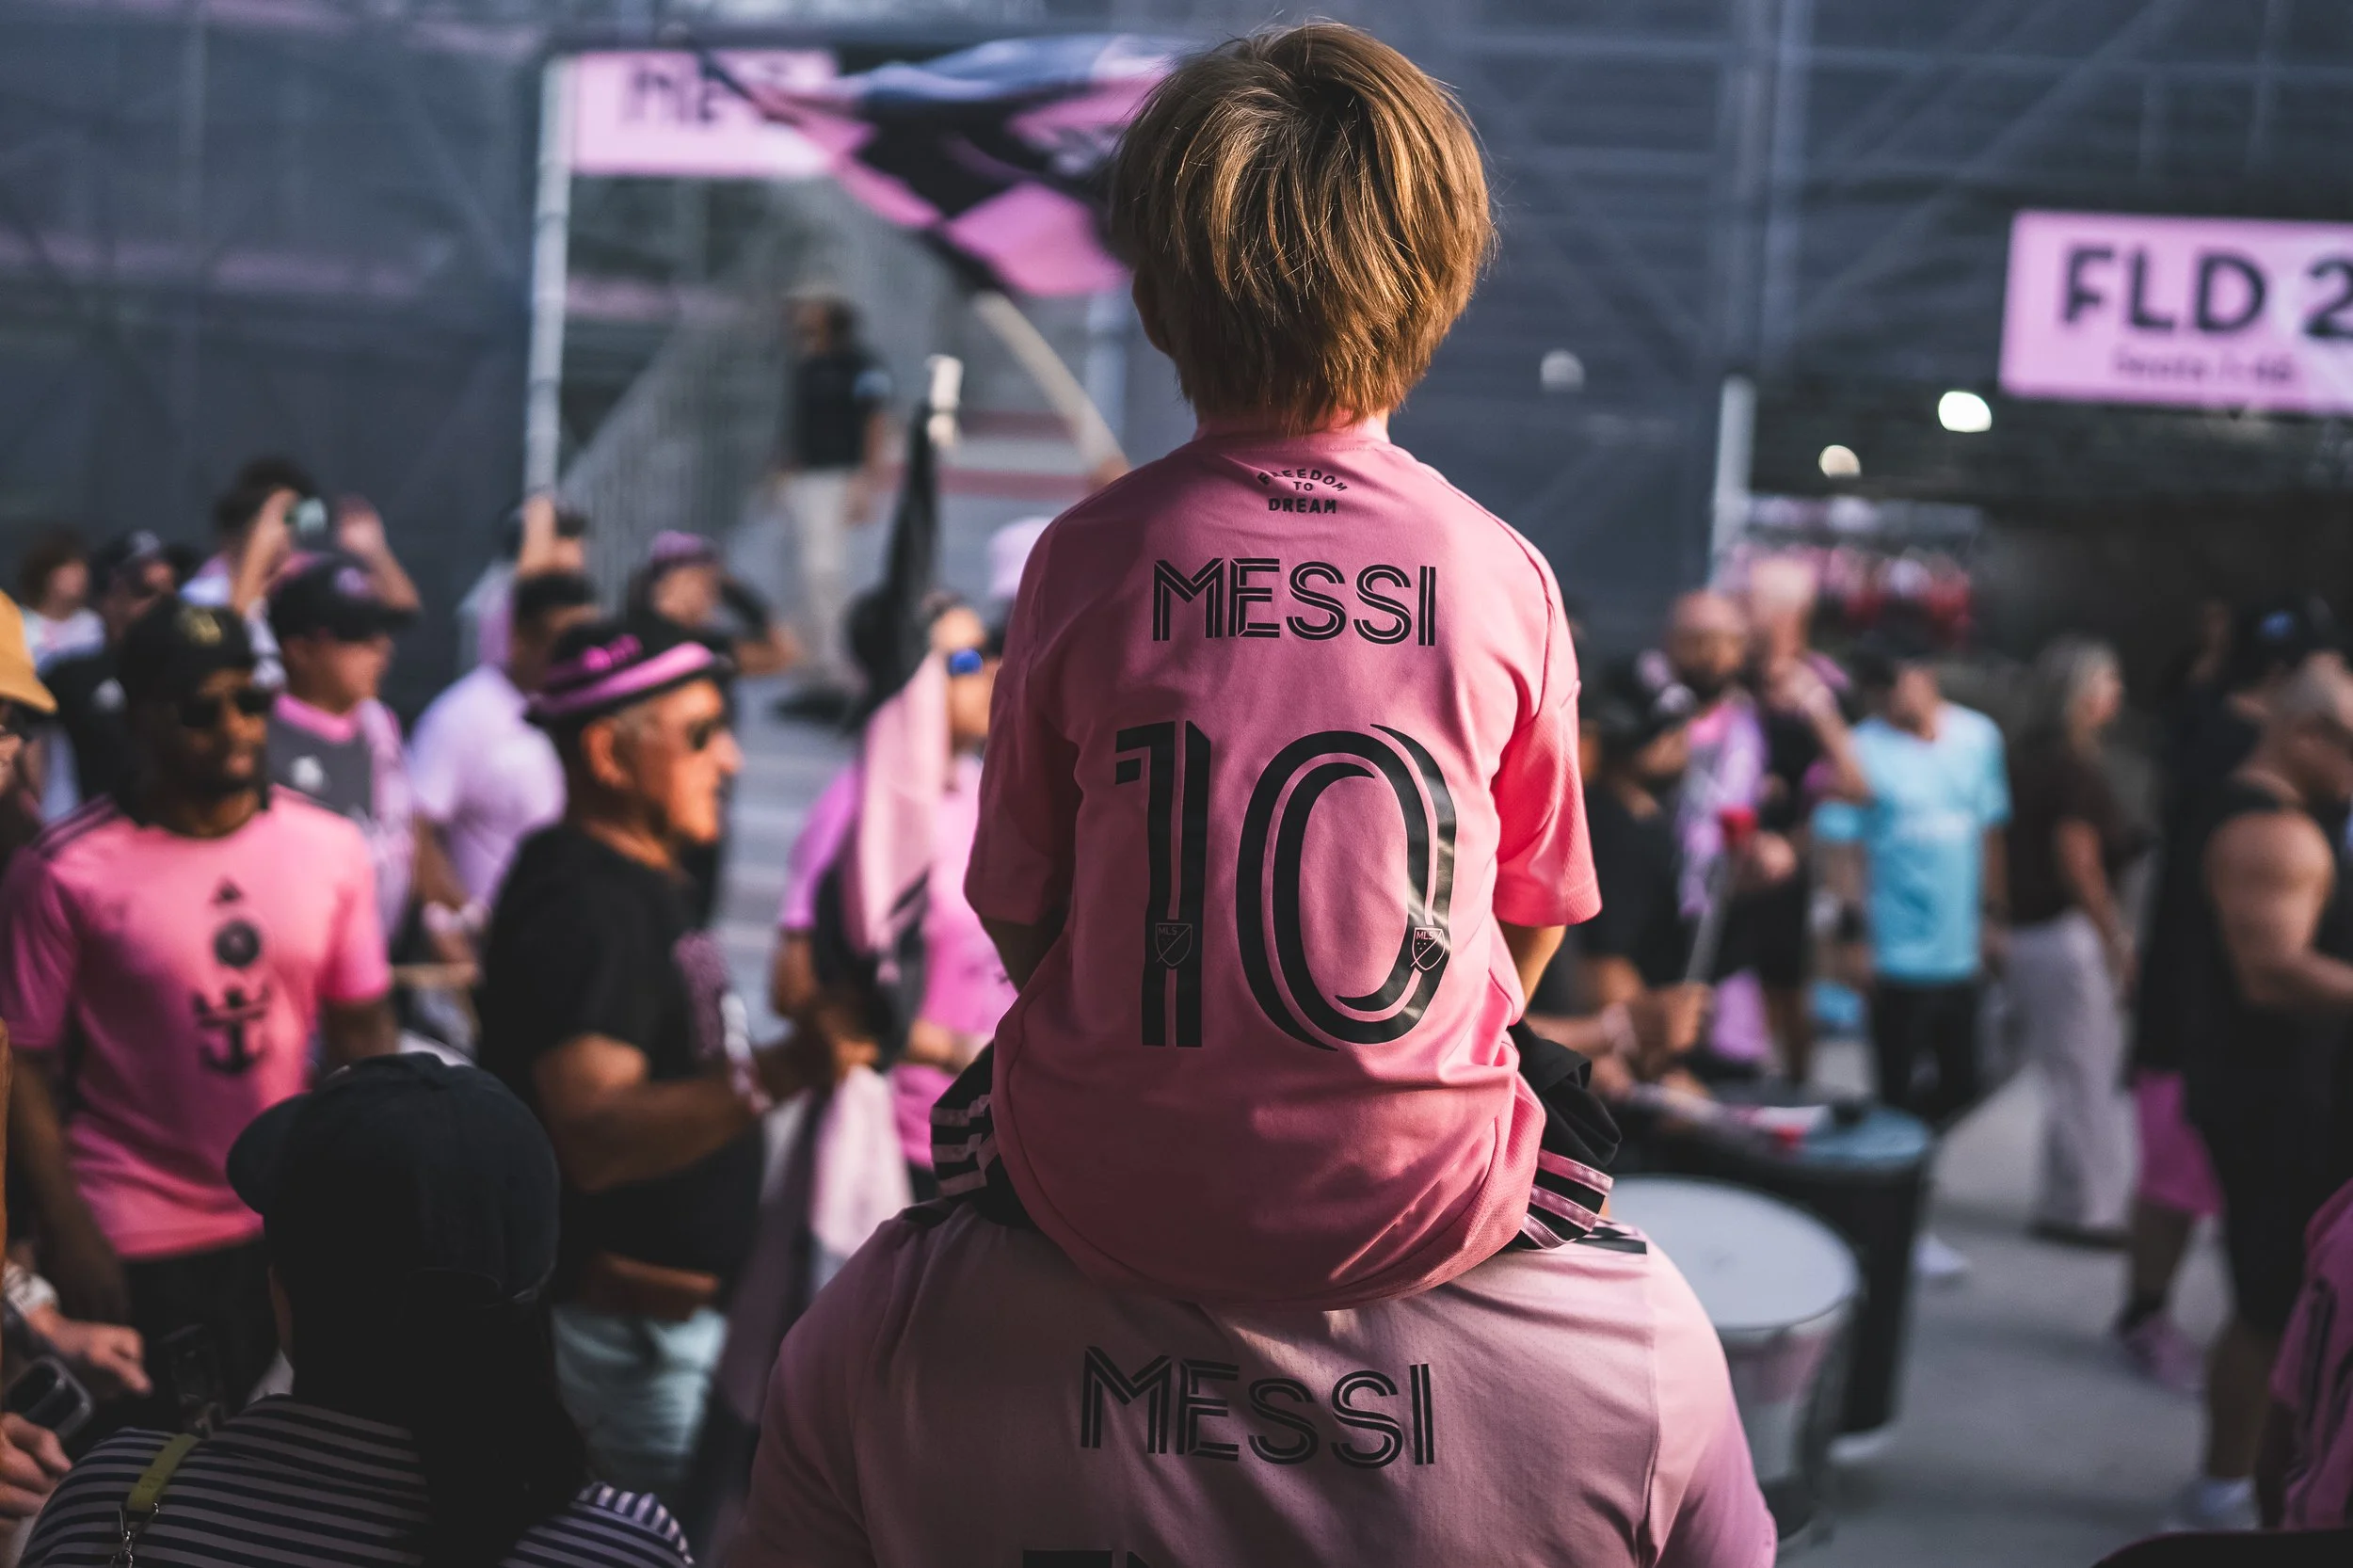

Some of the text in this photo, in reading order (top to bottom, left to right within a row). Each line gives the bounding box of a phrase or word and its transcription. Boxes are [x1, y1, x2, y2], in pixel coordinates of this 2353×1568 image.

[2061, 245, 2267, 333] FLD
[1268, 498, 1337, 514] DREAM
[1293, 481, 1314, 491] TO
[1153, 557, 1436, 647] MESSI
[1115, 720, 1457, 1051] 10
[1159, 926, 1177, 936] MLS
[1416, 931, 1435, 940] MLS
[1080, 1346, 1435, 1469] MESSI
